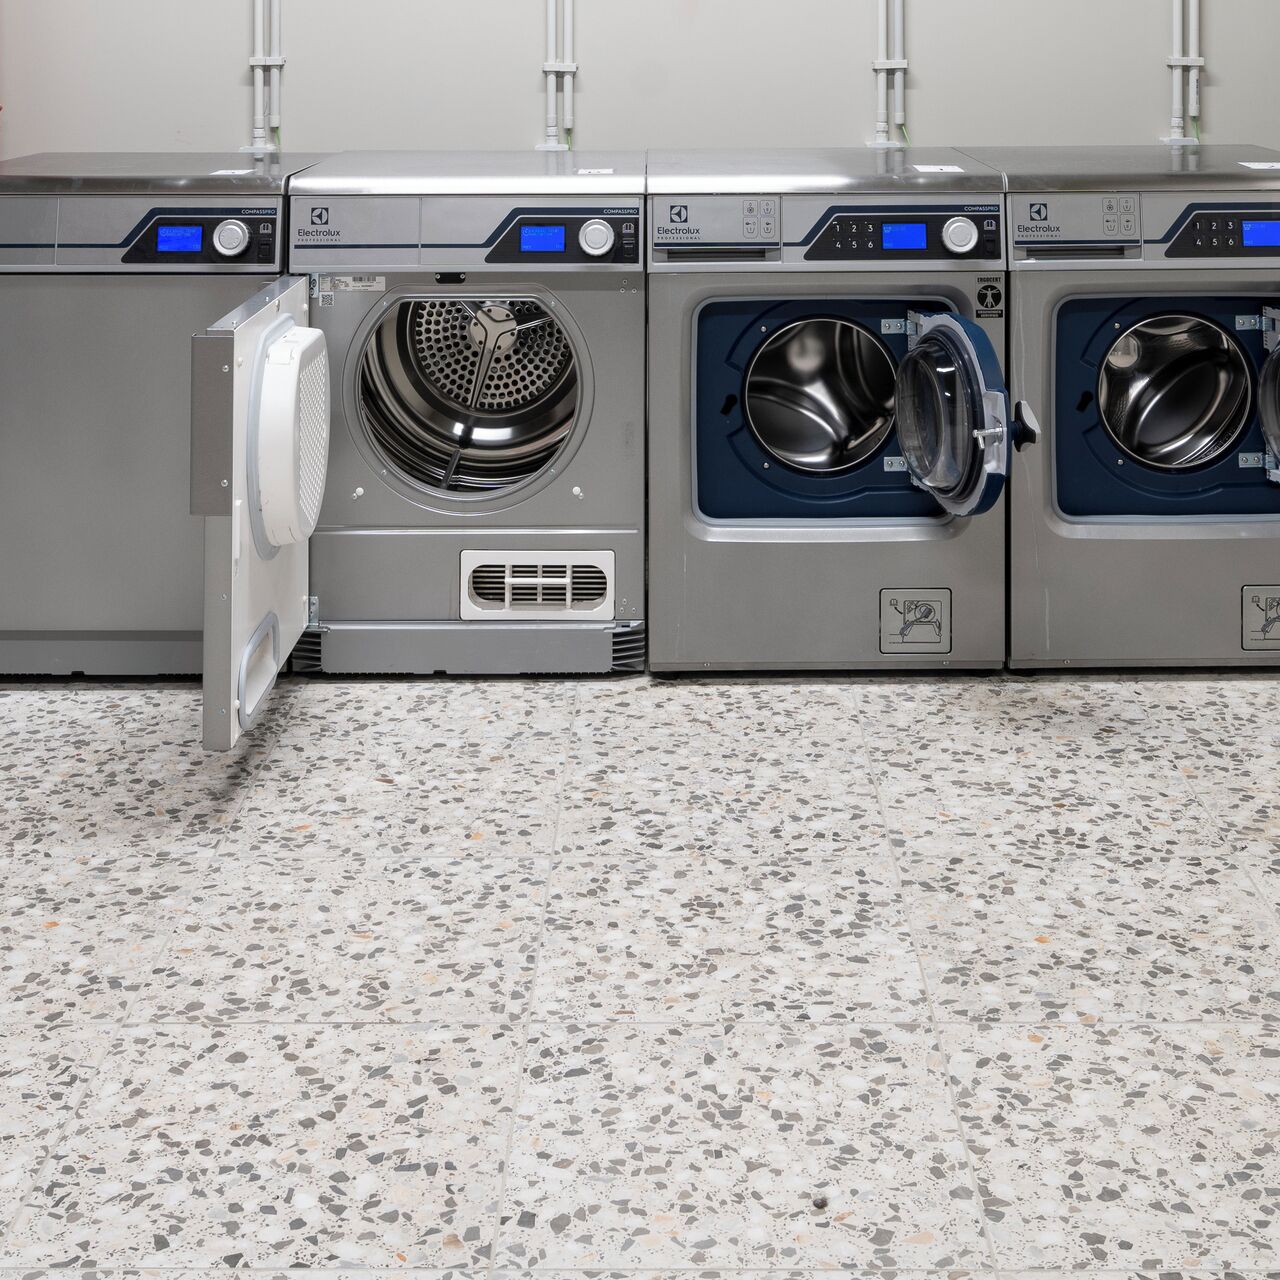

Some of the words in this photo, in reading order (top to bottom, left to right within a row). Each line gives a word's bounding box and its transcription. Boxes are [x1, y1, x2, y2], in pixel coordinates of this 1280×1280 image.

[657, 226, 700, 235] Electrolux
[1017, 224, 1060, 232] Electrolux
[297, 228, 341, 237] Electrolux
[835, 241, 841, 249] 4
[852, 241, 857, 249] 5
[868, 241, 873, 249] 6
